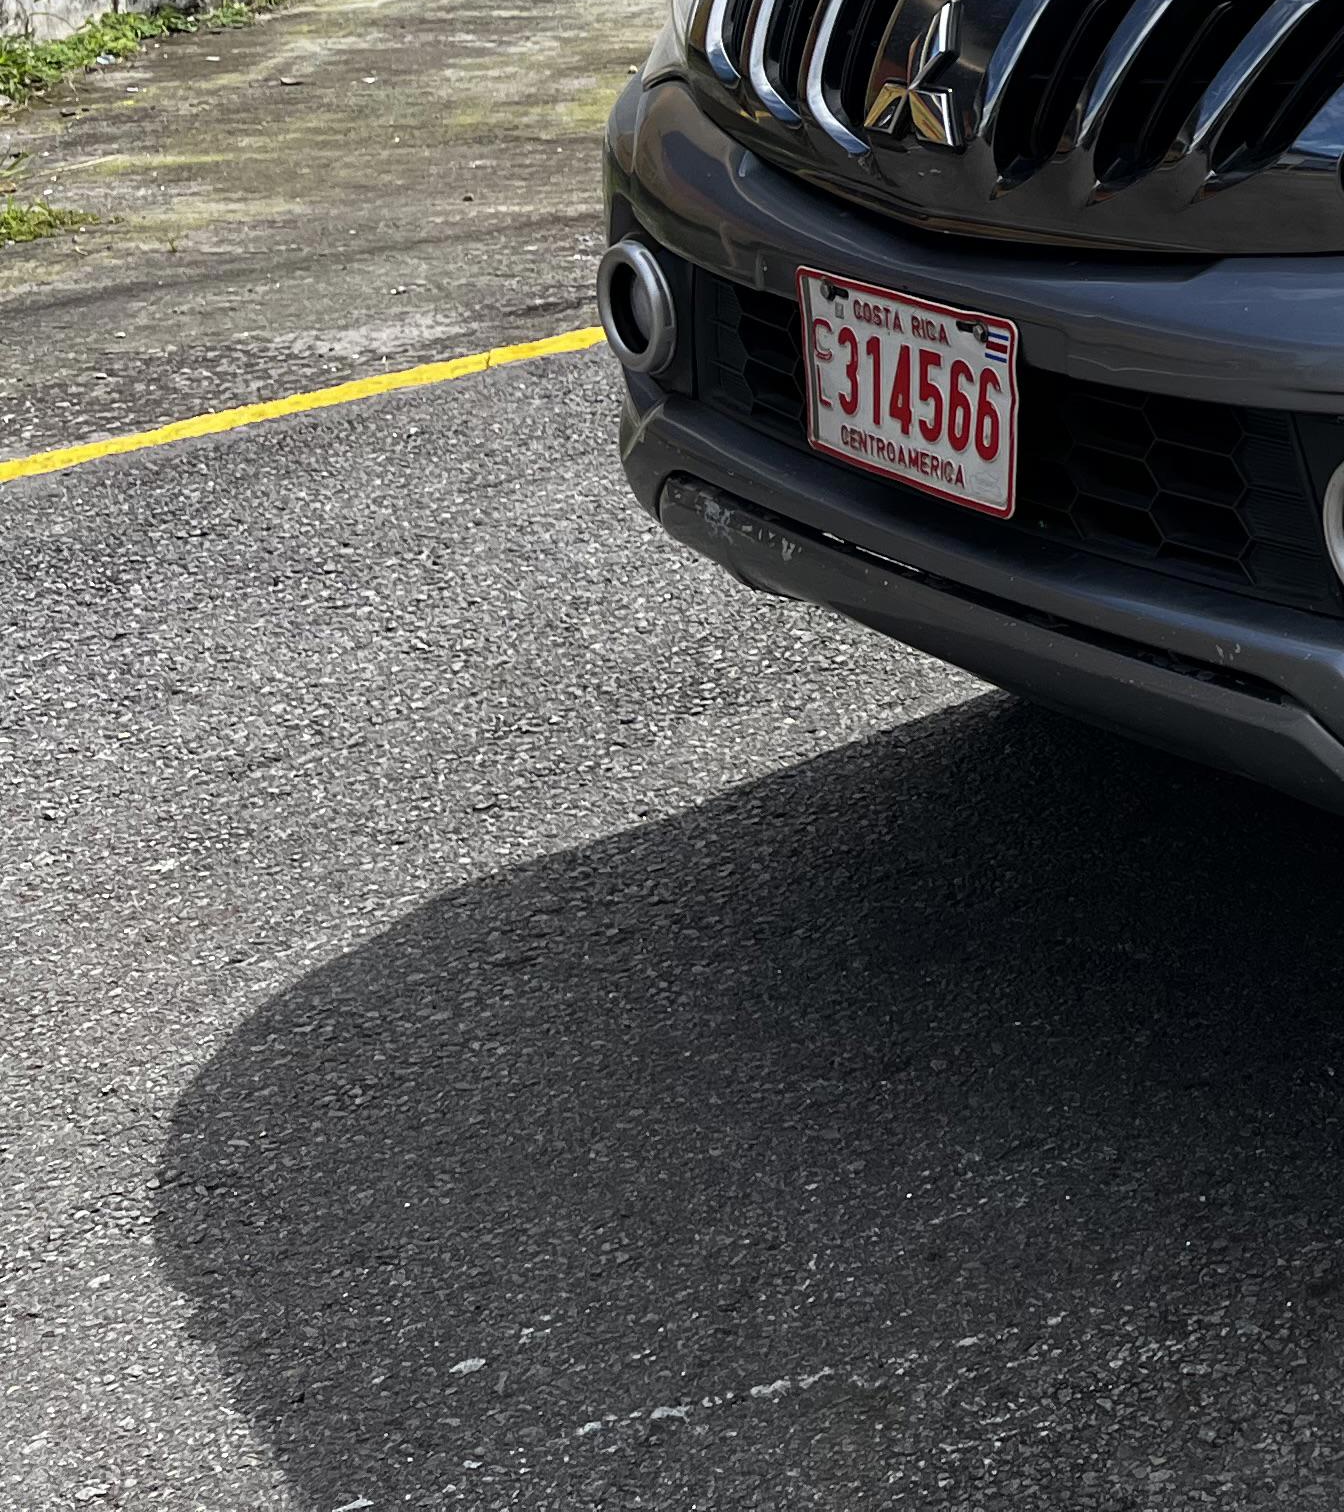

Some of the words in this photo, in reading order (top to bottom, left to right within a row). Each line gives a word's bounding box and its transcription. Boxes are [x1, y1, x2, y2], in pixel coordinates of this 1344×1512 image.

[853, 299, 904, 333] COSTA
[911, 317, 951, 347] RICA
[837, 326, 1002, 463] 314566
[840, 424, 966, 489] CENTROAMERICA
